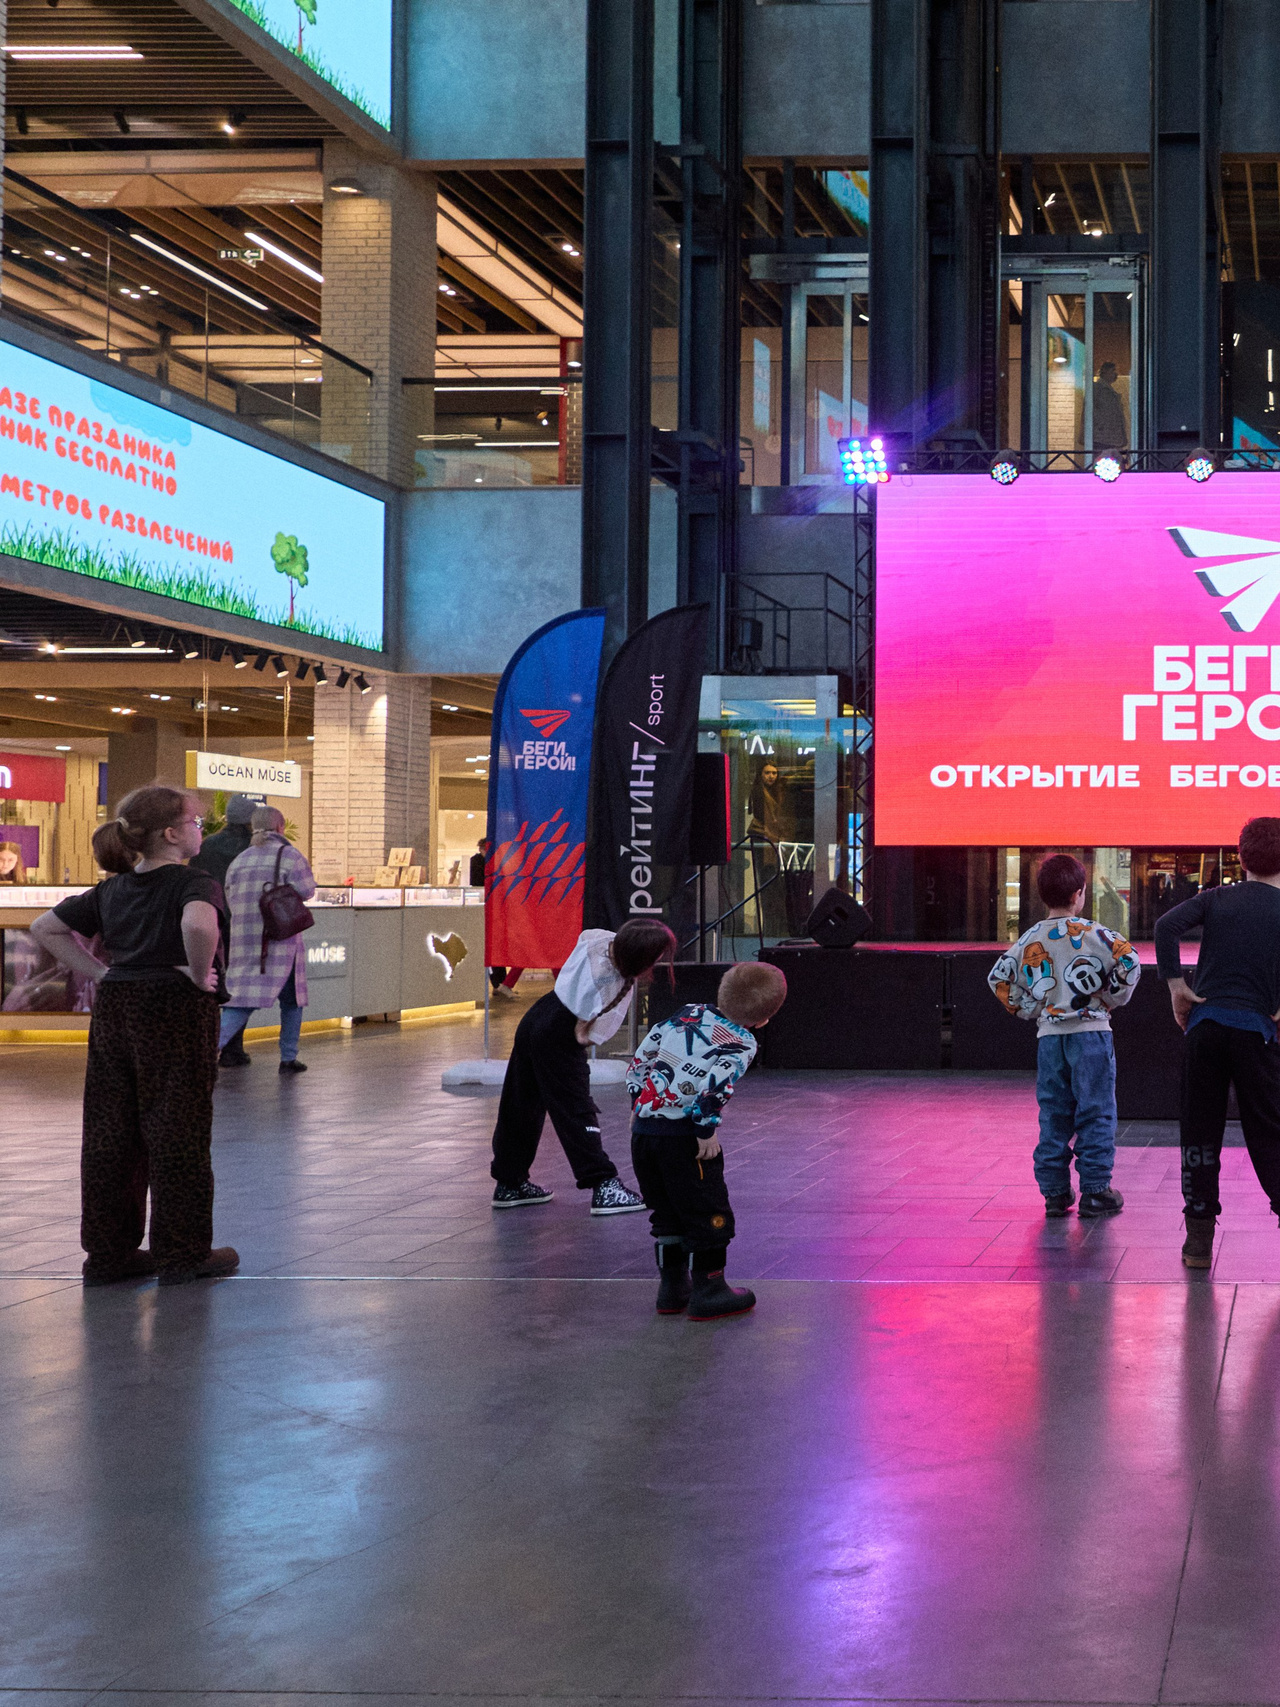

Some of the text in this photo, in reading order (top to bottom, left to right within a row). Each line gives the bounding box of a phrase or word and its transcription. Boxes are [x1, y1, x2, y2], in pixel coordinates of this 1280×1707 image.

[48, 405, 176, 471] ПРАЗДНИКА
[54, 436, 178, 496] БЕСПЛАТНО
[0, 473, 234, 564] МЕТРОВ РАЗВЛЕЧЕНИЙ
[523, 740, 569, 757] БЕГИ,
[208, 762, 253, 779] OCEAN
[515, 753, 576, 771] ГЕРОЙ!
[929, 764, 1140, 788] ОТКРЫТИЕ
